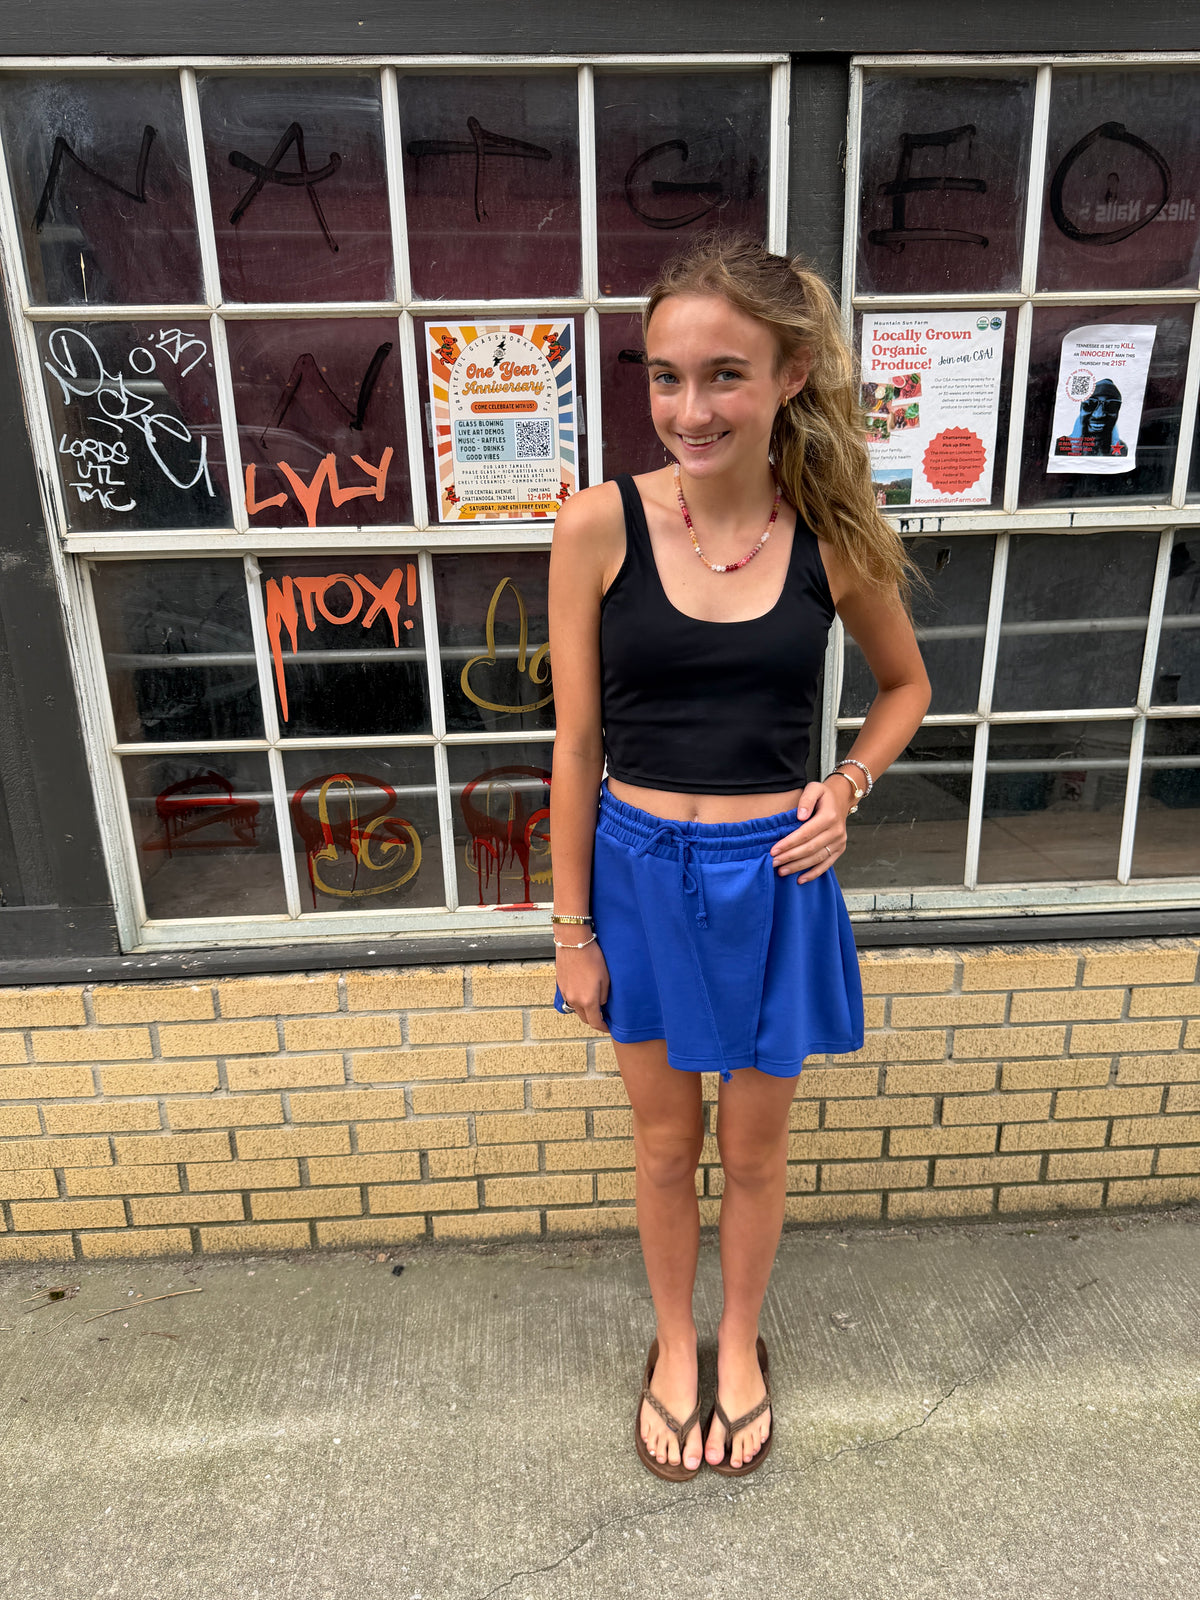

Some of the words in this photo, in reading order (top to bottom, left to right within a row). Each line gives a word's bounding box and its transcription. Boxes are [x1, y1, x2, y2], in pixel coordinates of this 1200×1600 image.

[872, 329, 922, 342] Locally
[926, 328, 972, 340] Grown
[872, 344, 928, 358] Organic
[938, 355, 956, 366] Join
[973, 347, 992, 361] CSA!
[871, 358, 932, 370] Produce!
[466, 363, 494, 380] One
[499, 362, 539, 382] Year
[462, 380, 545, 396] Anniversary
